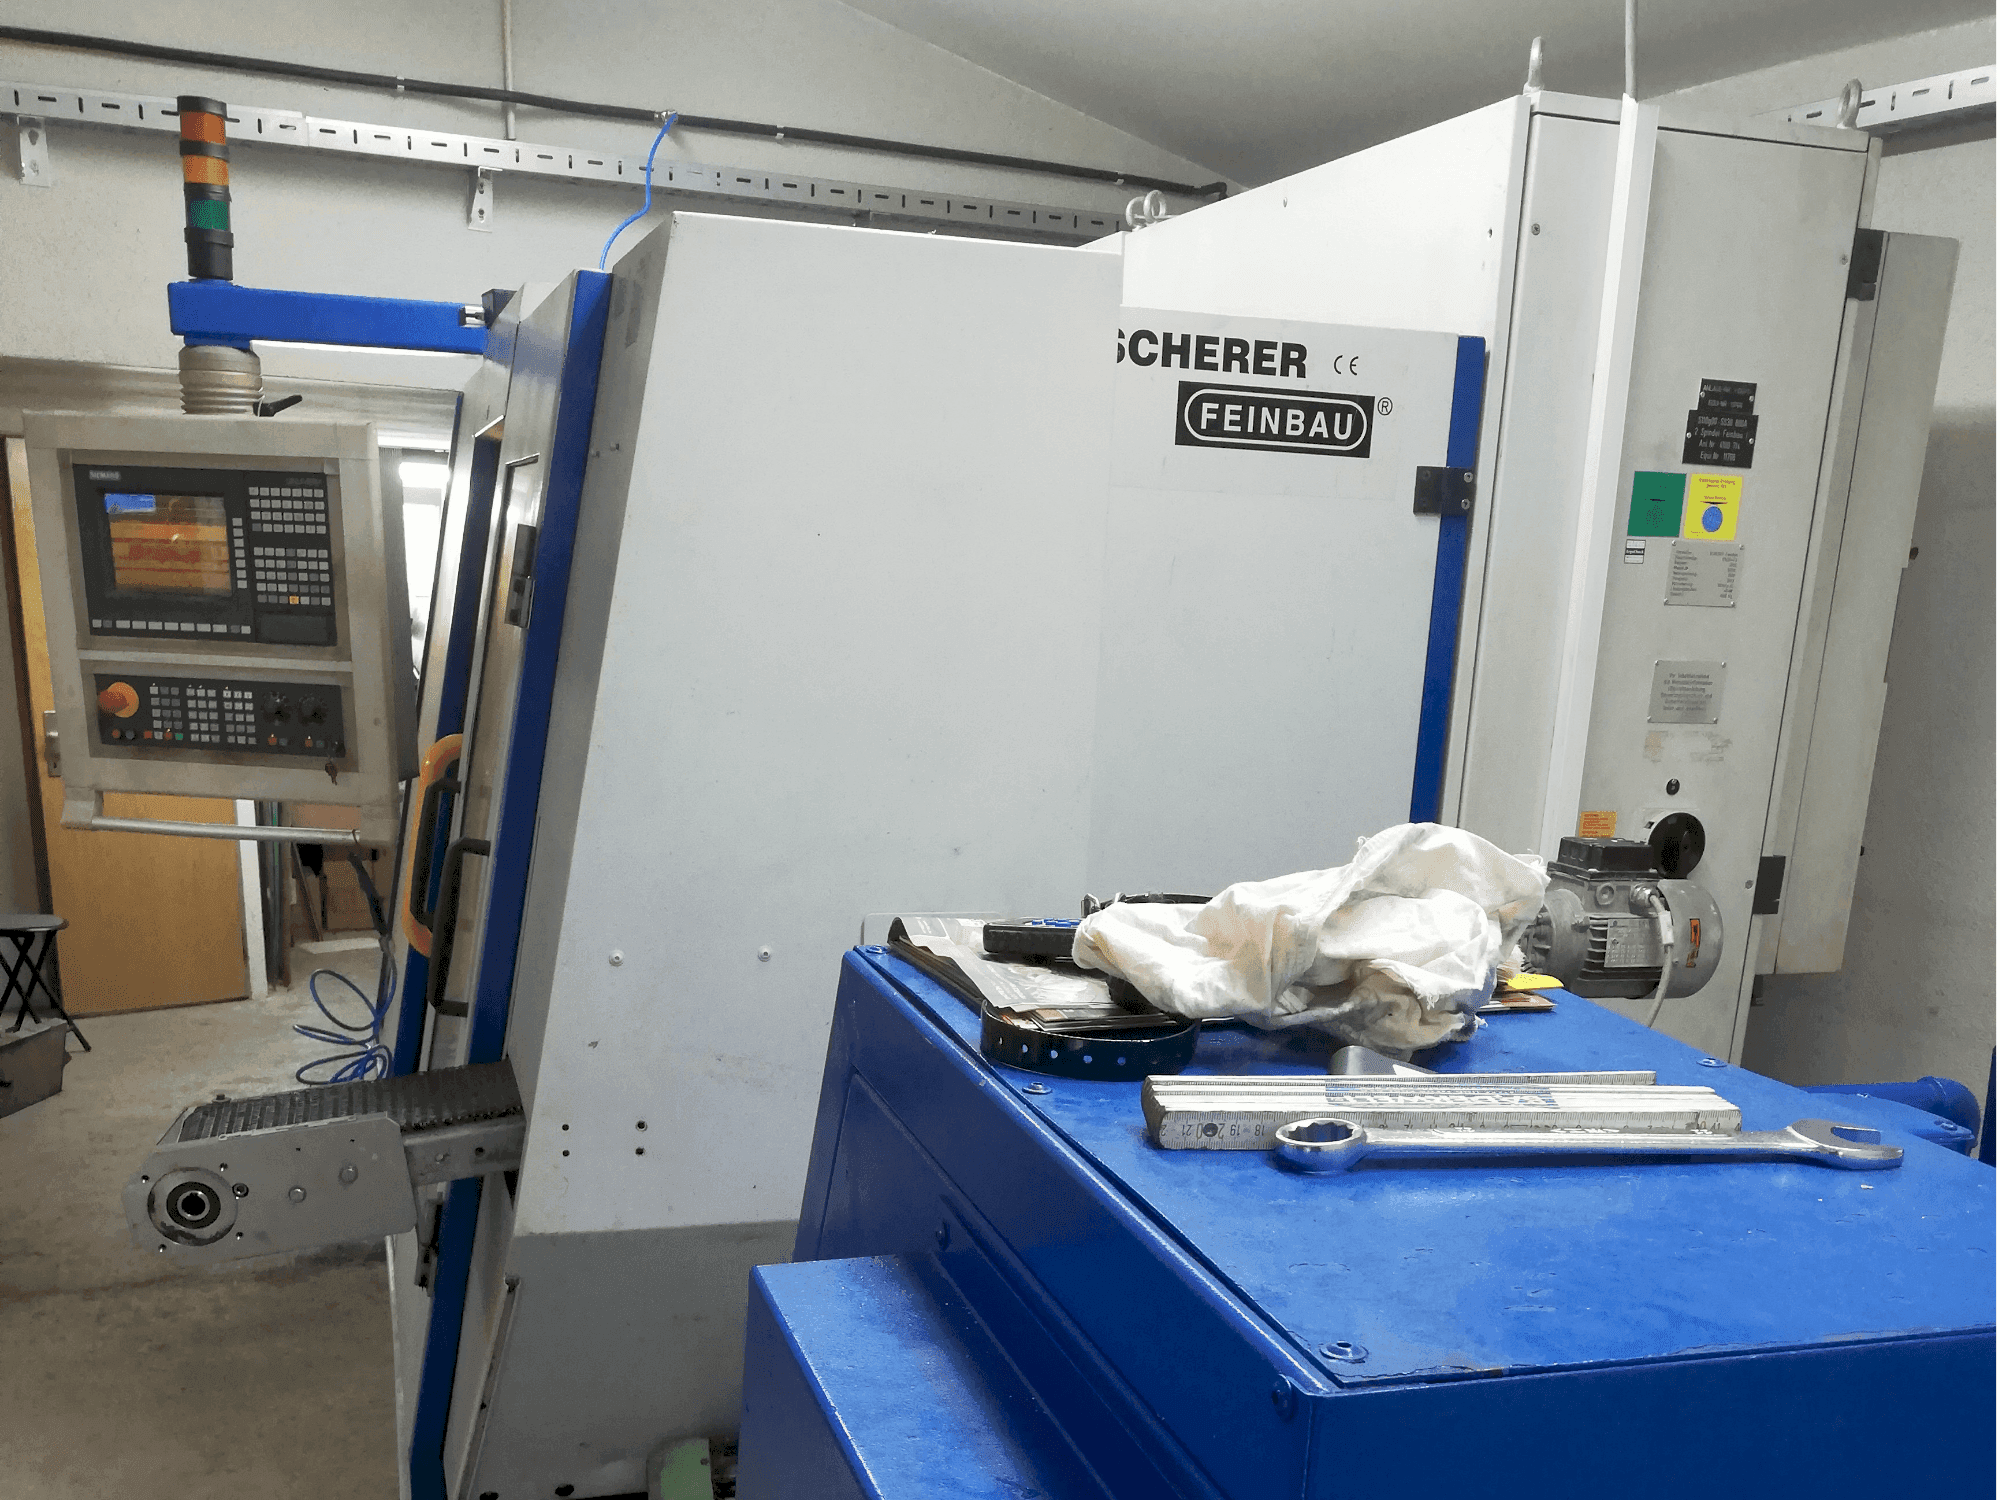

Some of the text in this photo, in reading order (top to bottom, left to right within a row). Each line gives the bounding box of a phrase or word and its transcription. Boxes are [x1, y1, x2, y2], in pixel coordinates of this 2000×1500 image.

[1117, 328, 1308, 378] CHERER
[1199, 401, 1353, 441] FEINBAU
[1160, 1124, 1167, 1137] 2
[1181, 1124, 1193, 1137] 21
[1229, 1124, 1241, 1137] 19
[1254, 1124, 1265, 1137] 18
